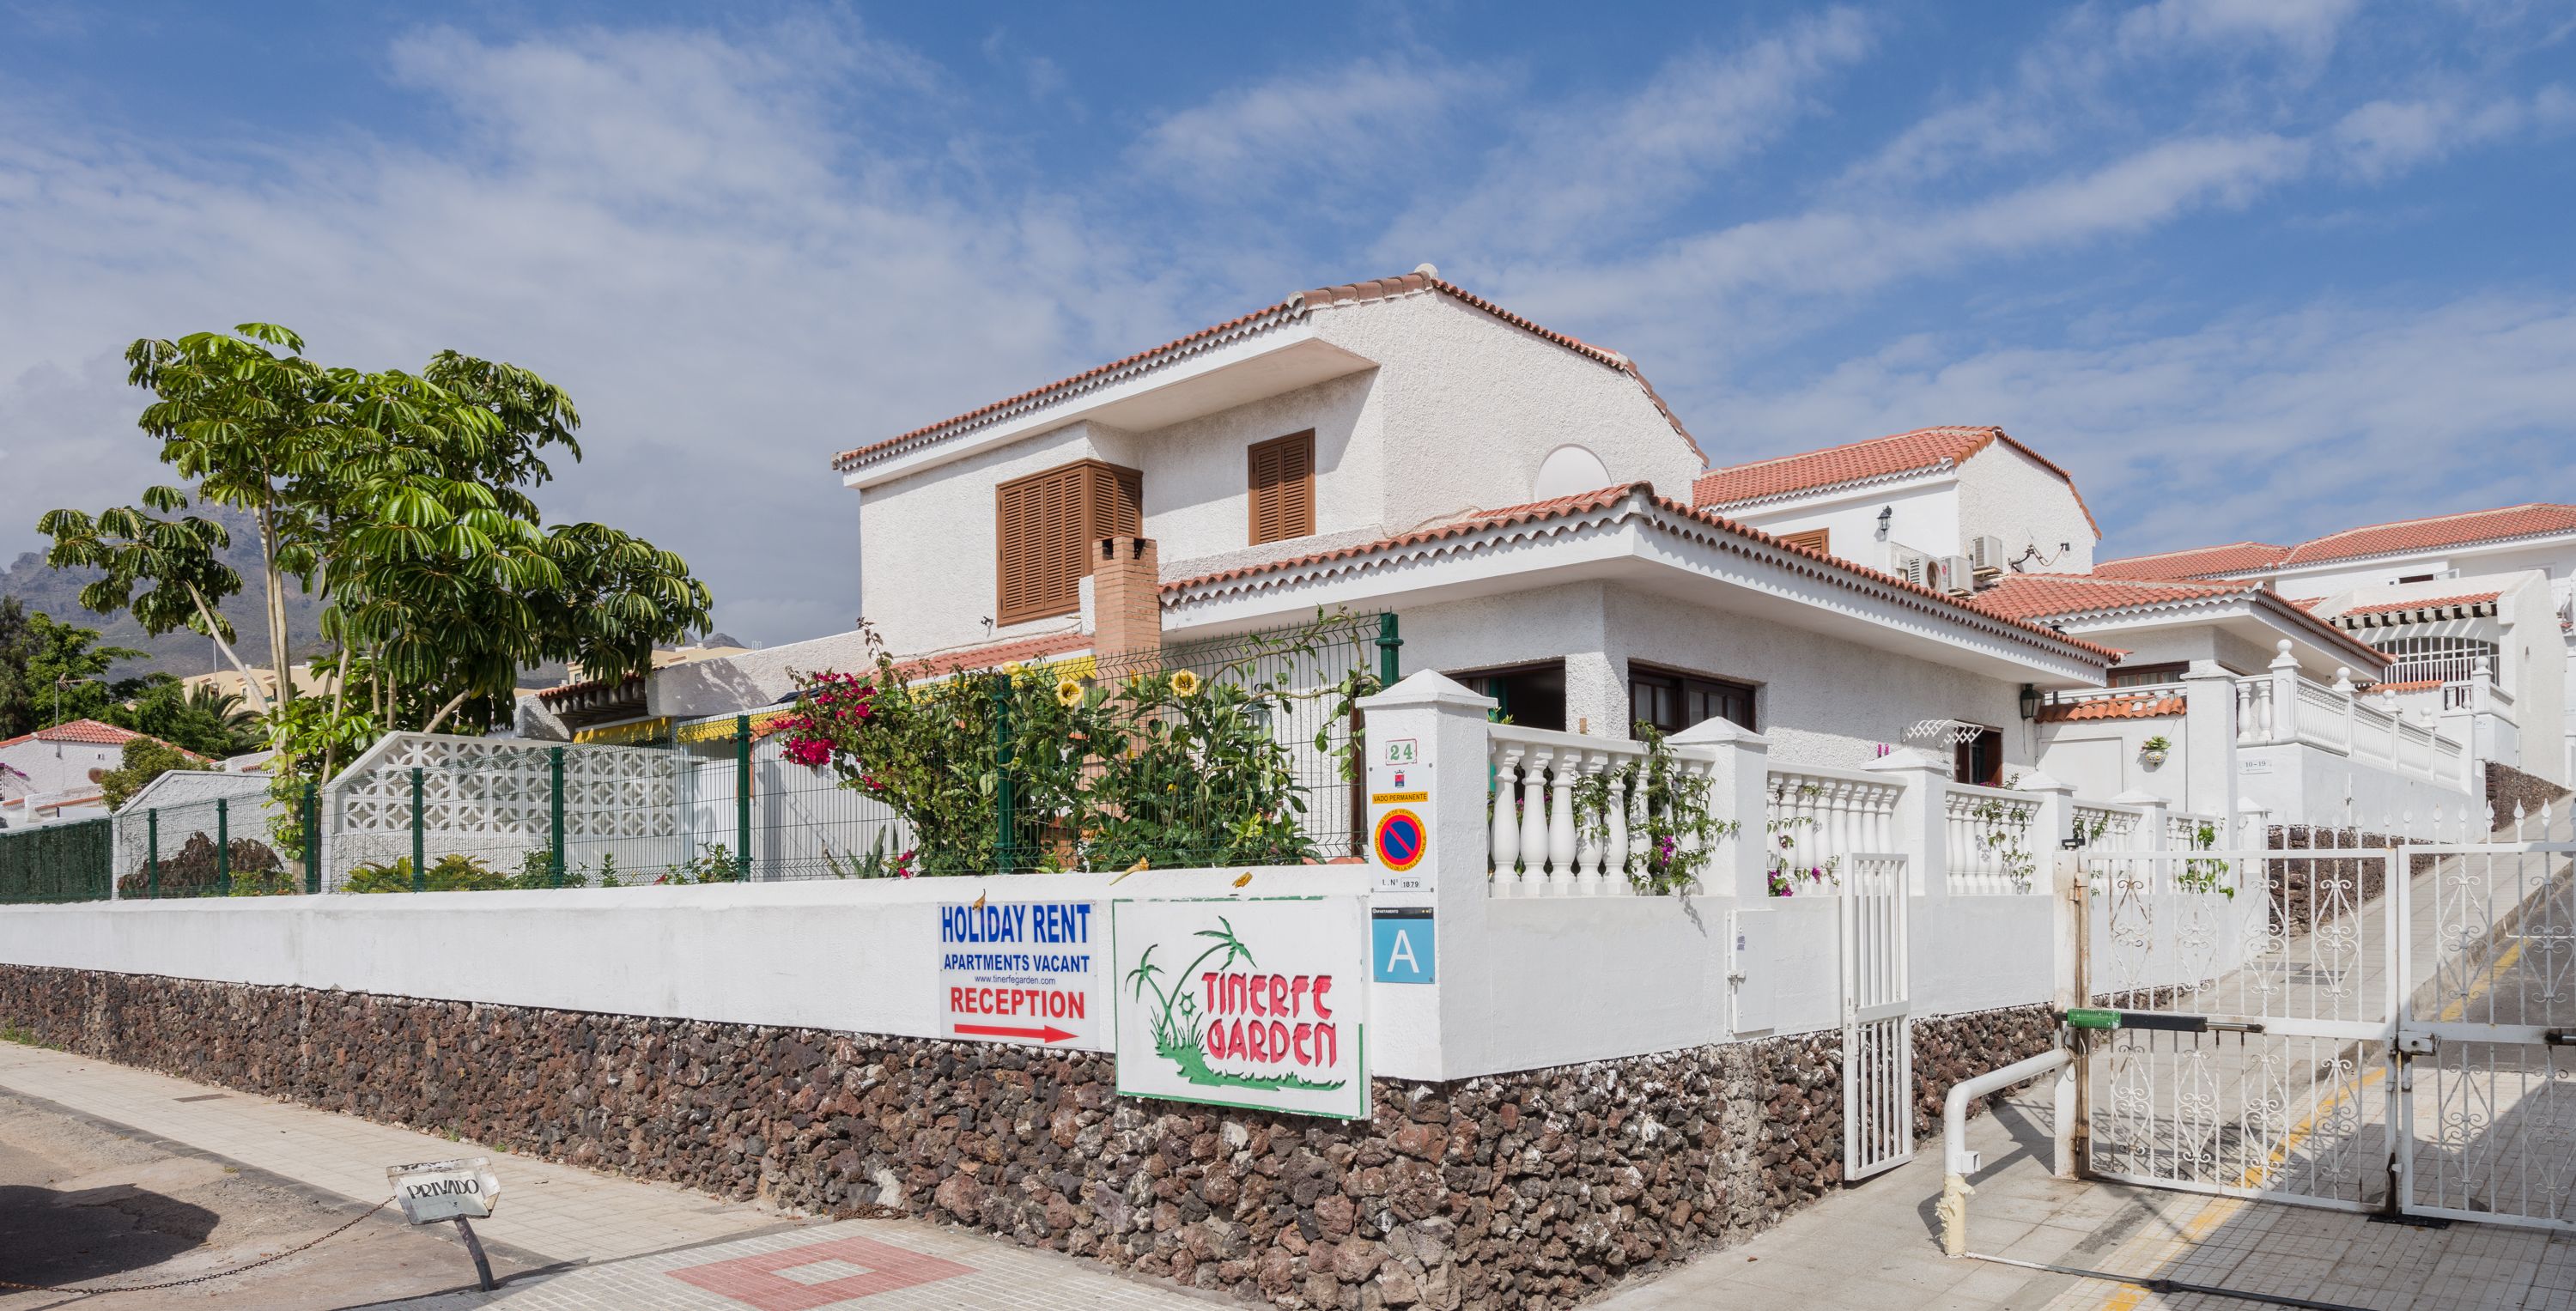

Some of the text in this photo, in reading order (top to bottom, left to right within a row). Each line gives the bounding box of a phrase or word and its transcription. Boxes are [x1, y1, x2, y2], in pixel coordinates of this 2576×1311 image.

[1390, 744, 1413, 761] 24
[1378, 812, 1391, 828] SALIDA
[1406, 859, 1419, 869] VILLA
[942, 904, 1091, 943] HOLIDAY RENT
[1387, 929, 1420, 974] A
[944, 954, 1090, 972] APARTMENTS VACANT
[975, 974, 1056, 986] www.tinerfegarden.com
[950, 986, 1085, 1019] RECEPTION
[1201, 972, 1333, 1020] TINERFE
[1206, 1017, 1337, 1068] GARDEN
[406, 1179, 480, 1199] PRIVADO
